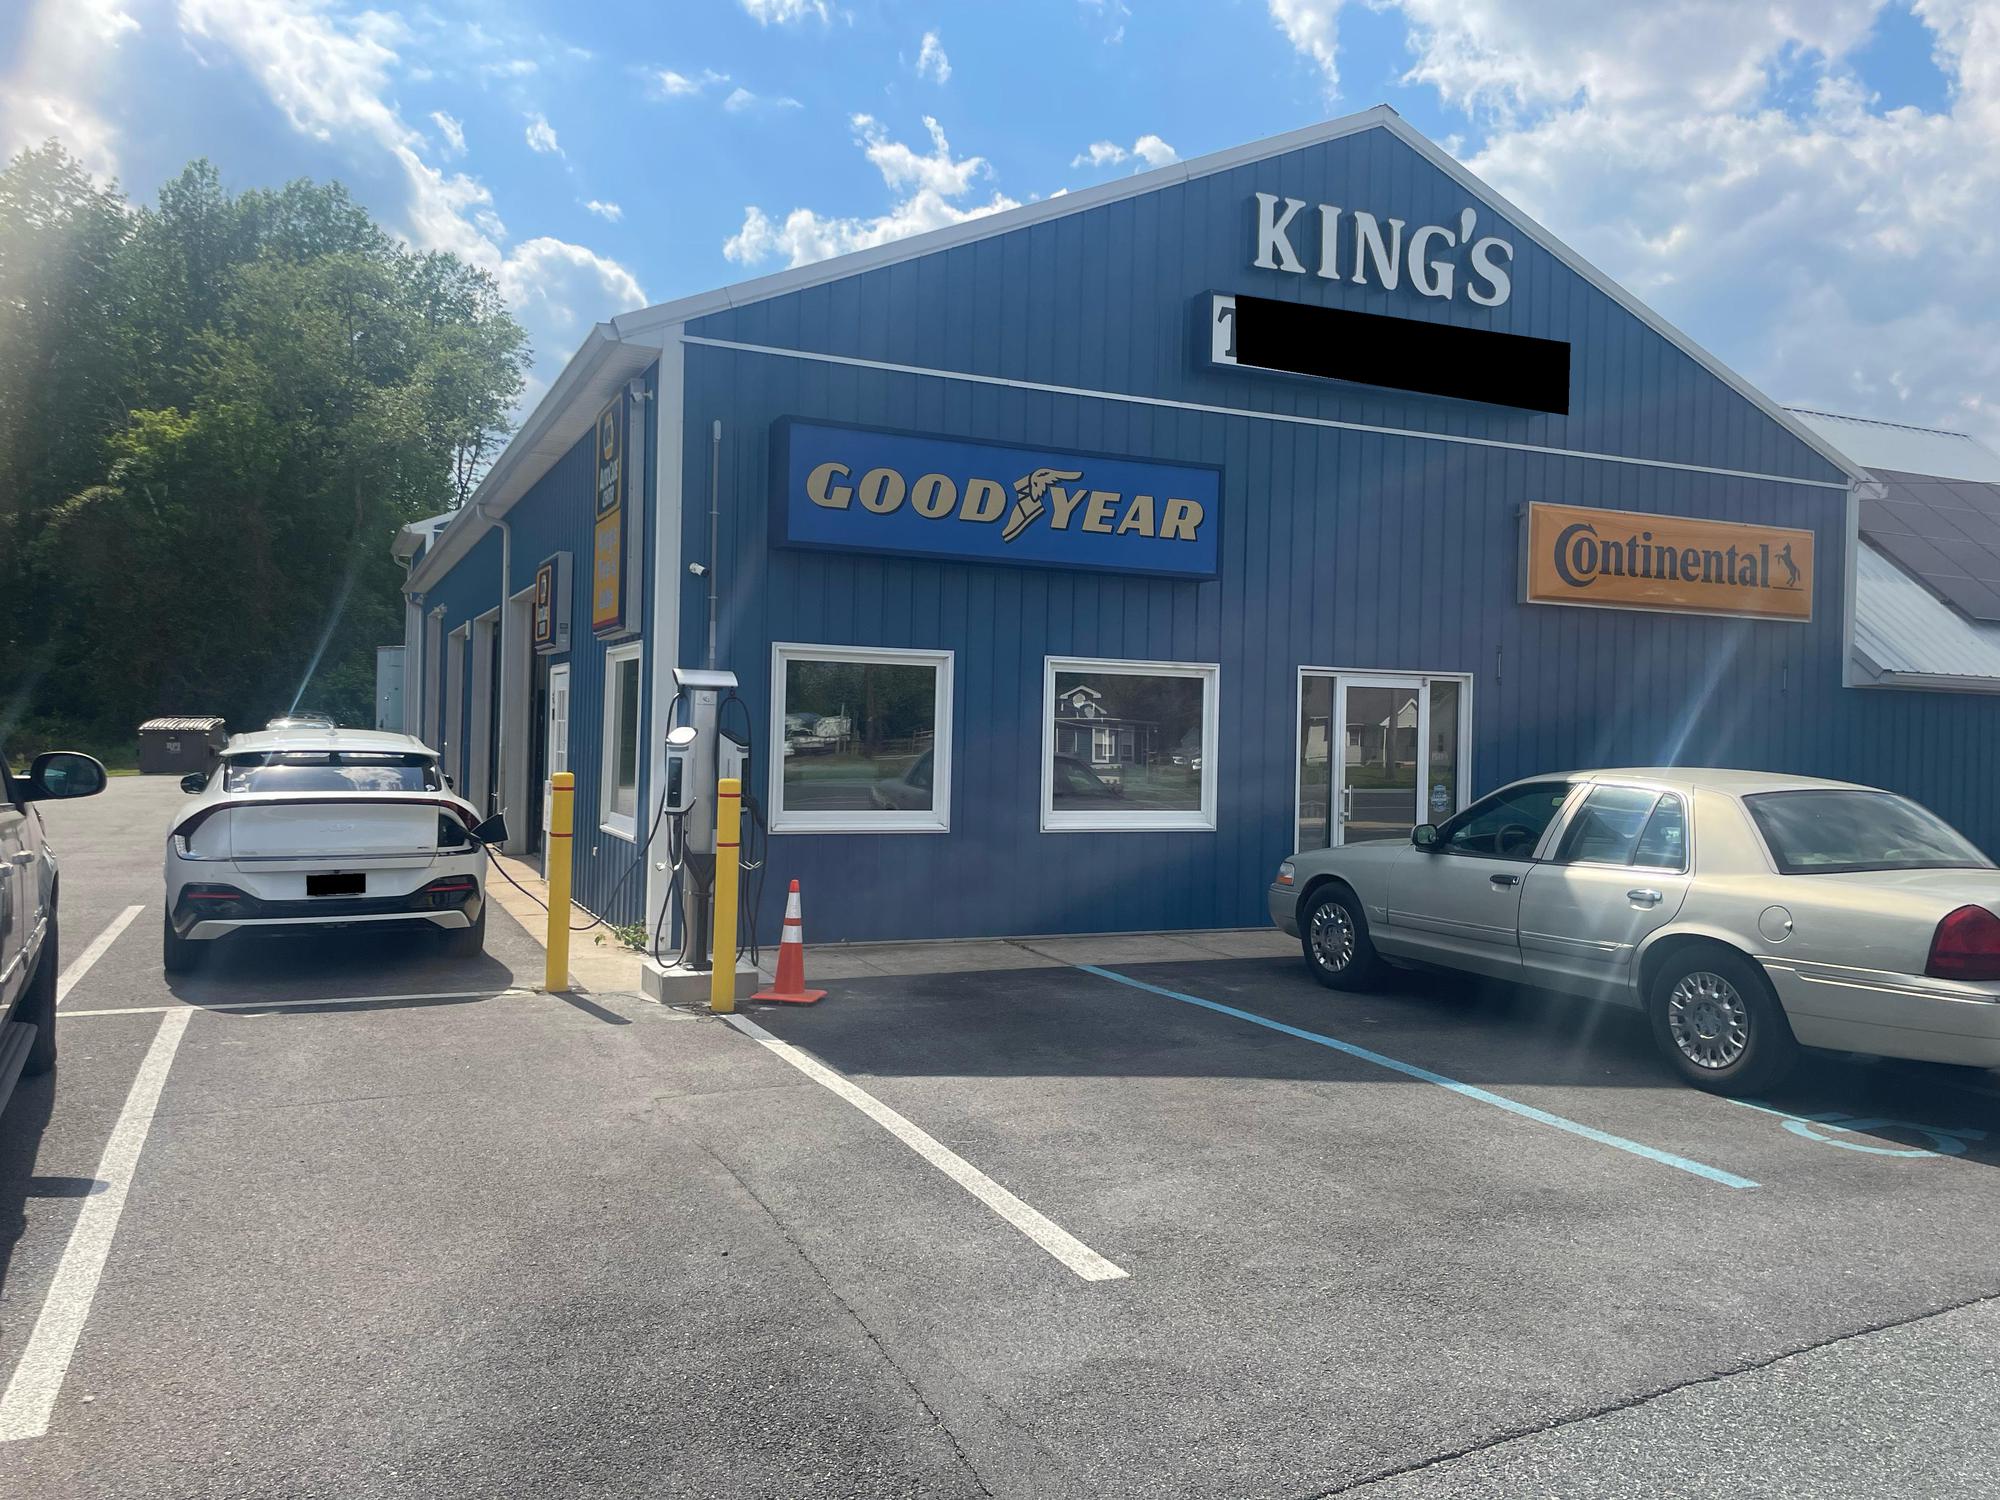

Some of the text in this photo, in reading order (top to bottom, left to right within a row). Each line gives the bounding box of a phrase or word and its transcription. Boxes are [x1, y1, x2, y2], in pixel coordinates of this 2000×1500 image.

[1252, 192, 1514, 307] KING'S
[806, 462, 1205, 542] GOODYEAR
[1554, 523, 1771, 589] Continental
